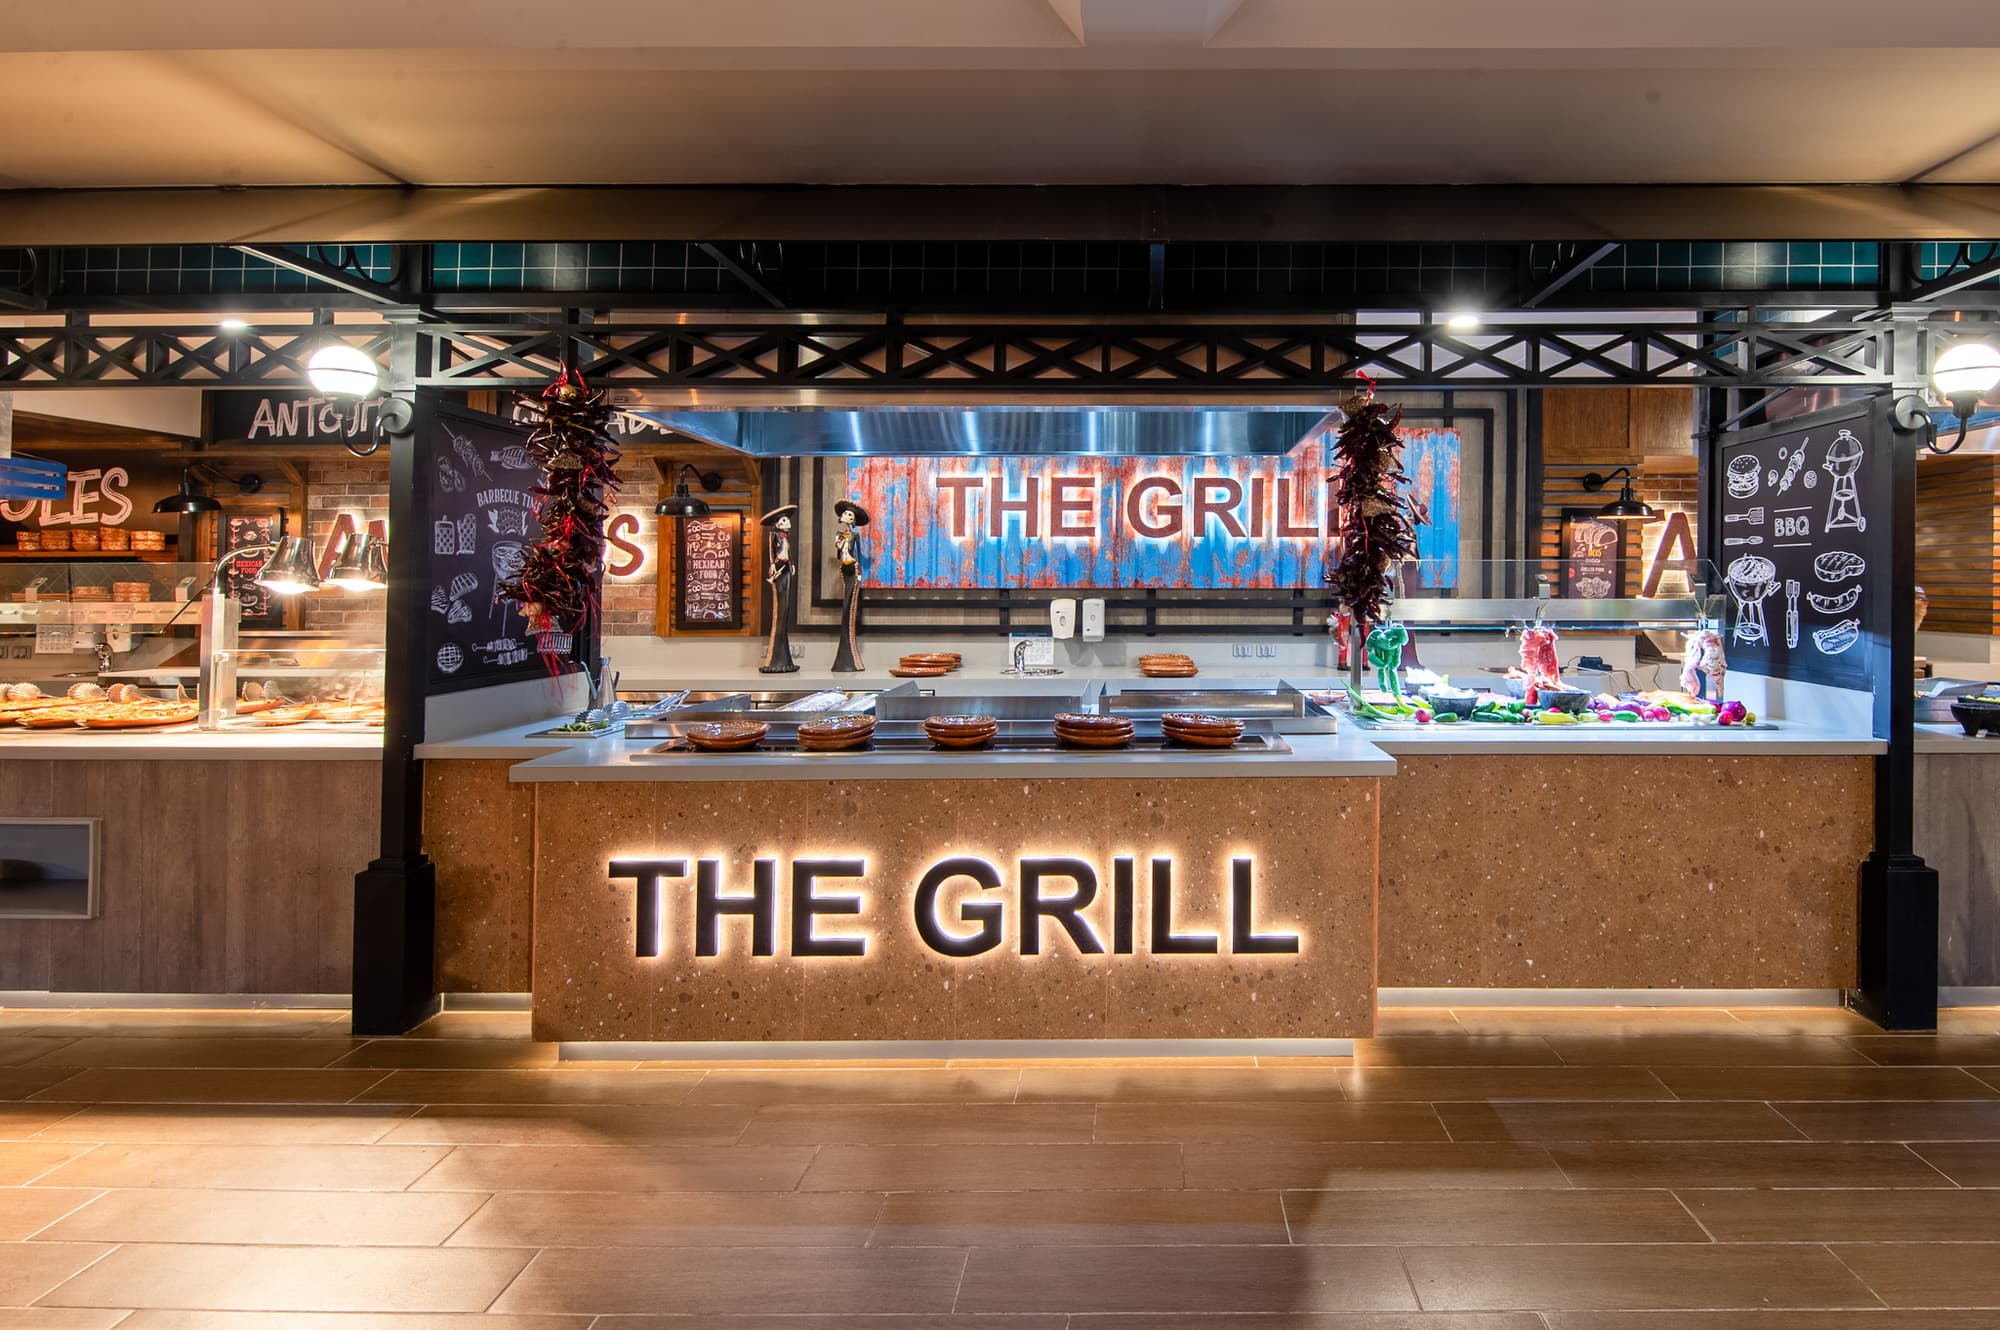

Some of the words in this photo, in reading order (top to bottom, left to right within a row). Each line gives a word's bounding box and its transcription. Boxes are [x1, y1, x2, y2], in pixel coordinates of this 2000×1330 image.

[476, 488, 520, 508] BARBECUE
[936, 477, 1096, 538] THE
[1774, 515, 1810, 537] BBQ
[692, 559, 726, 570] MEXICAN
[608, 858, 866, 957] THE
[913, 856, 1300, 957] GRILL
